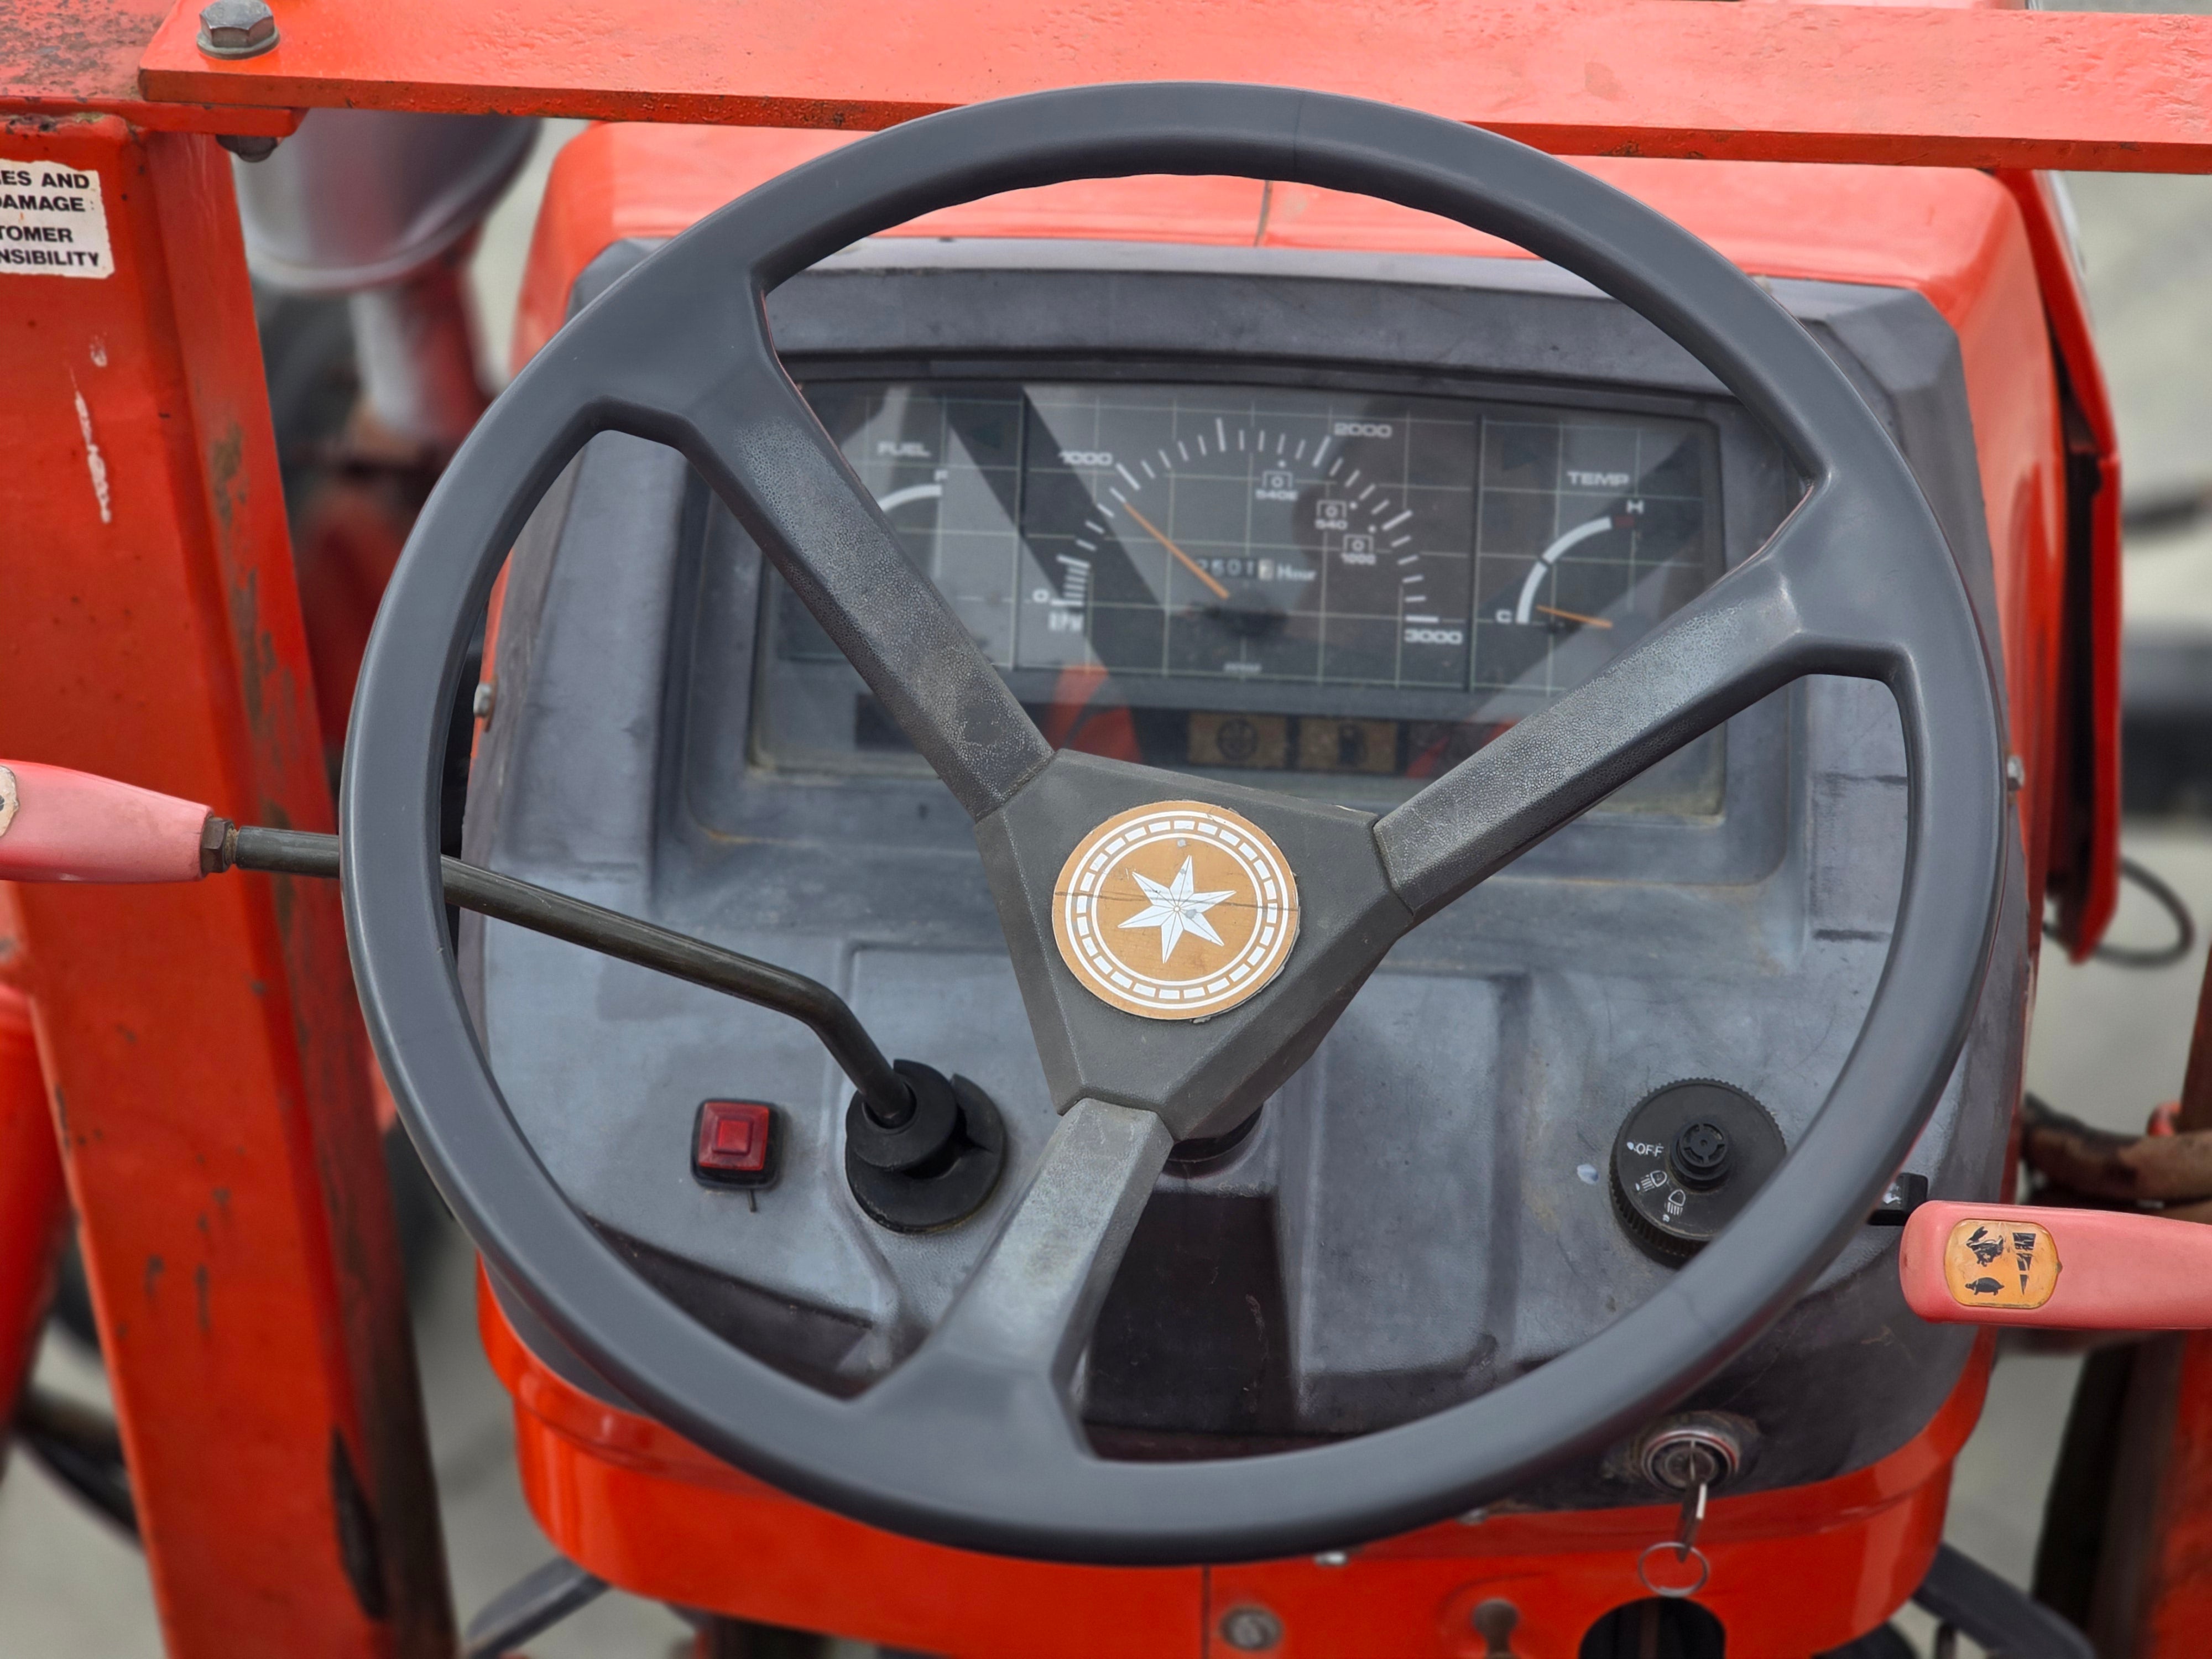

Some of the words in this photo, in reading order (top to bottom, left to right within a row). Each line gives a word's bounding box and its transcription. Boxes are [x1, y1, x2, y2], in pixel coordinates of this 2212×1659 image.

[0, 170, 32, 186] ES
[41, 173, 90, 189] AND
[0, 194, 86, 212] AMAGE
[1334, 422, 1392, 438] 2000
[877, 442, 931, 457] FUEL
[1059, 451, 1113, 466] 1000
[934, 470, 948, 481] F
[1567, 471, 1630, 487] TEMP
[1626, 500, 1644, 514] H
[1496, 610, 1512, 624] C
[1404, 629, 1463, 645] 3000
[1636, 1142, 1664, 1157] OFF
